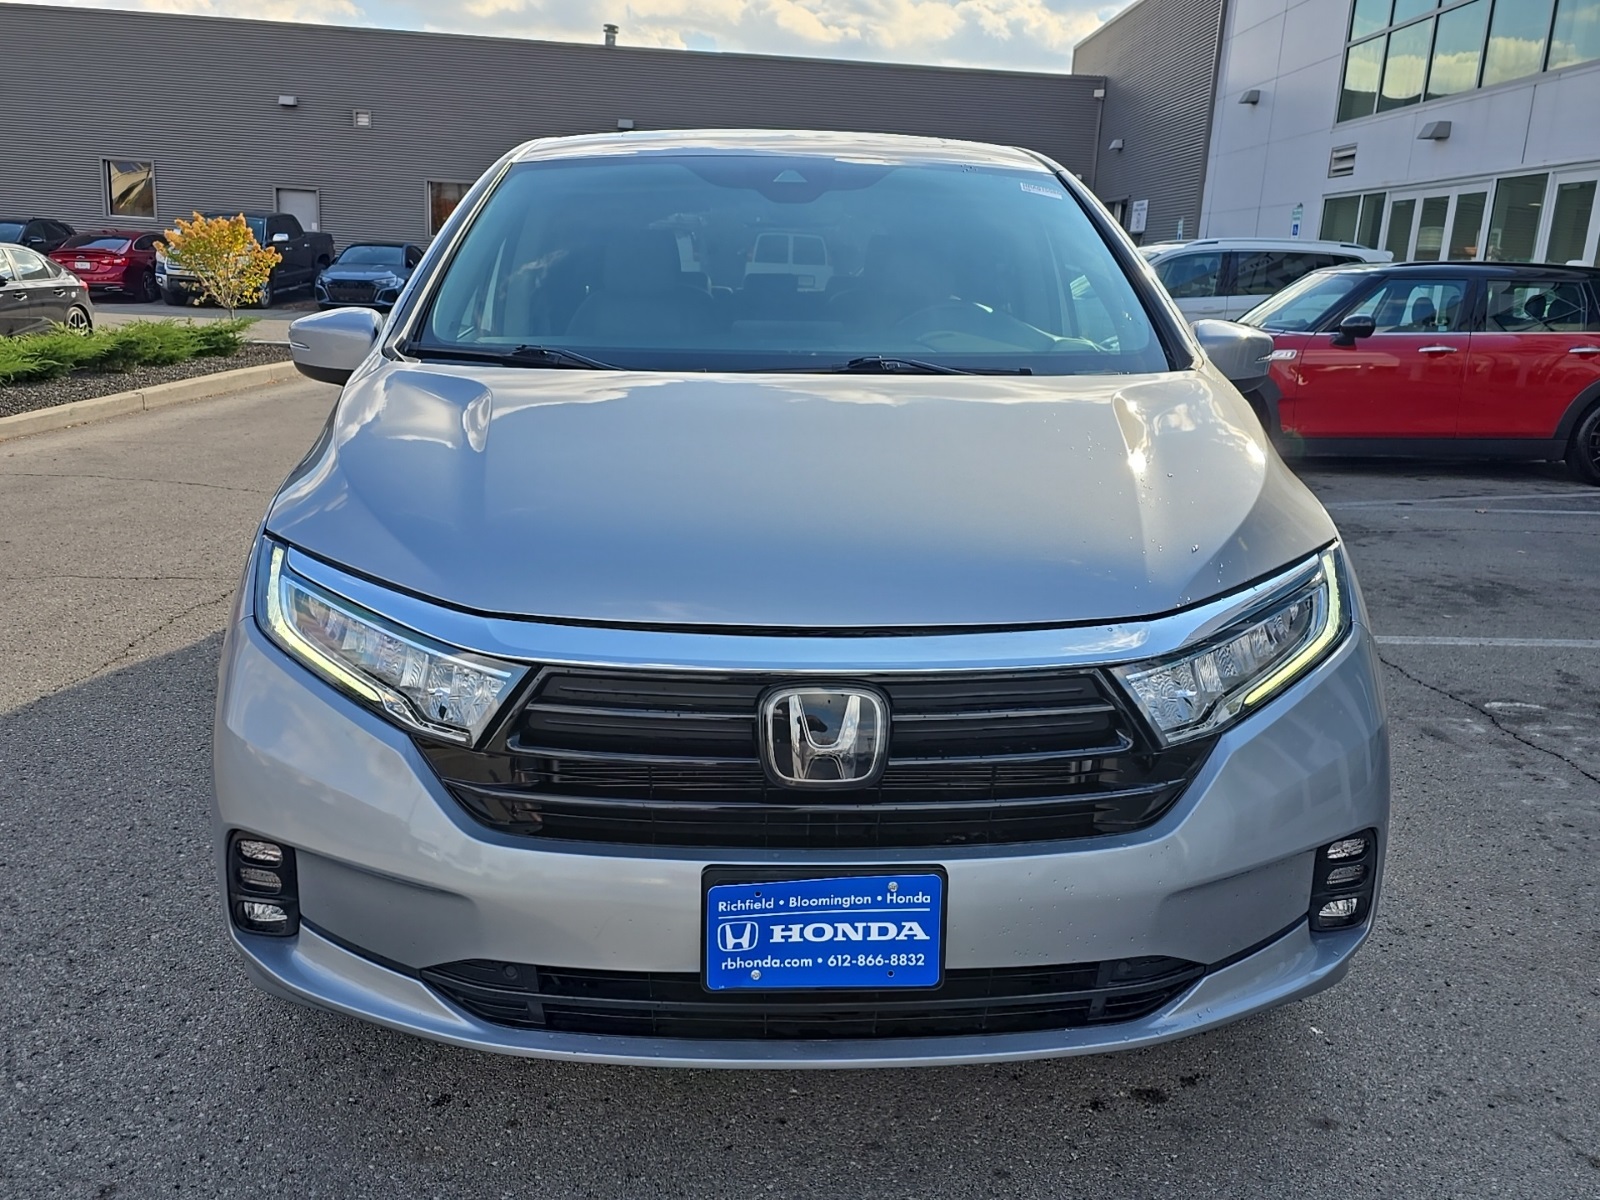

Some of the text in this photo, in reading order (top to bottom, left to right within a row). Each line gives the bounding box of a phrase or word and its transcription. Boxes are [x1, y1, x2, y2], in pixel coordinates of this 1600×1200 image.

[718, 891, 931, 912] Richfield Bloomington Honda
[769, 921, 930, 943] HONDA
[721, 953, 925, 970] rbhonda.com 612-866-8832
